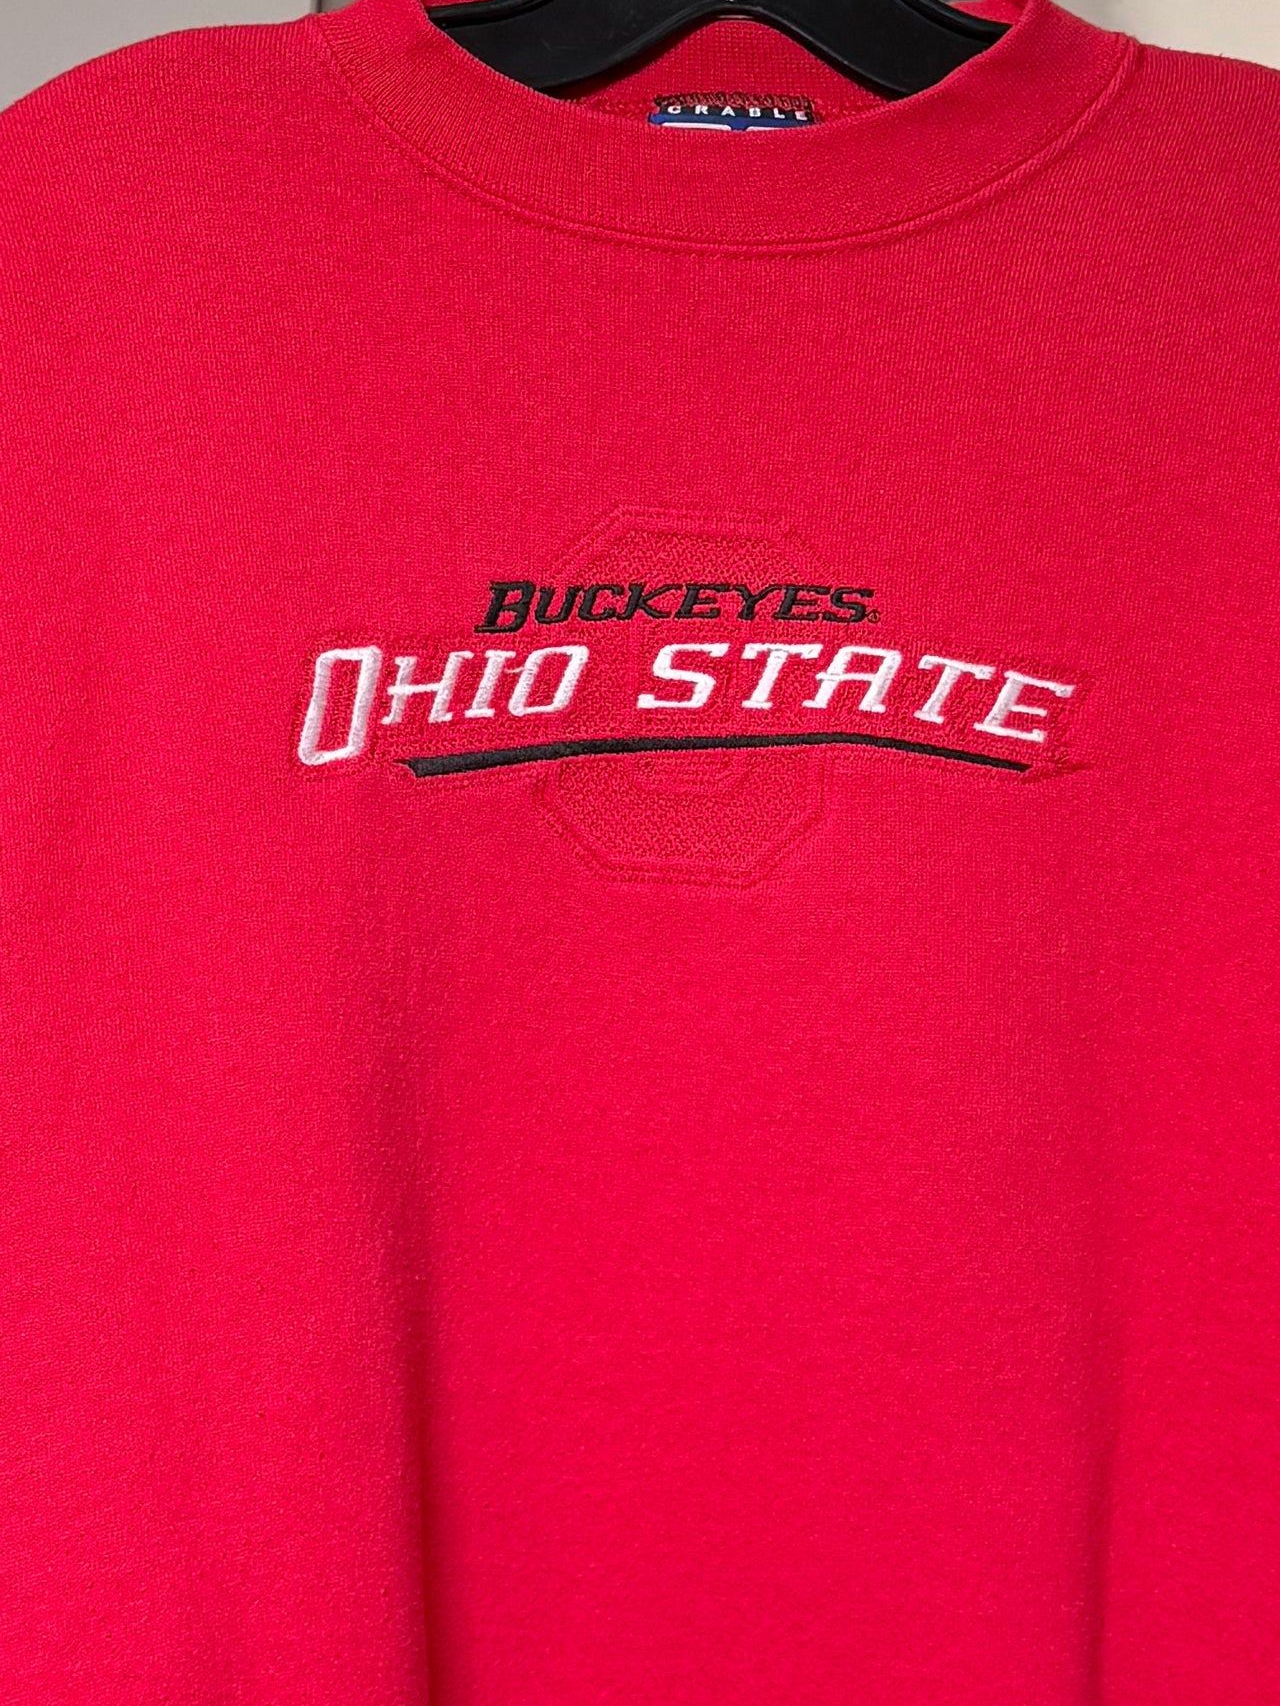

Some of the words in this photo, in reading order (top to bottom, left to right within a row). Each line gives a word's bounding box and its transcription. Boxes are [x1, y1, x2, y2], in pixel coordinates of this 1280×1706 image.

[667, 104, 808, 121] CRABLE
[476, 579, 874, 634] BUCKEYES
[300, 640, 588, 767] OHIO
[637, 642, 1076, 743] STATE
